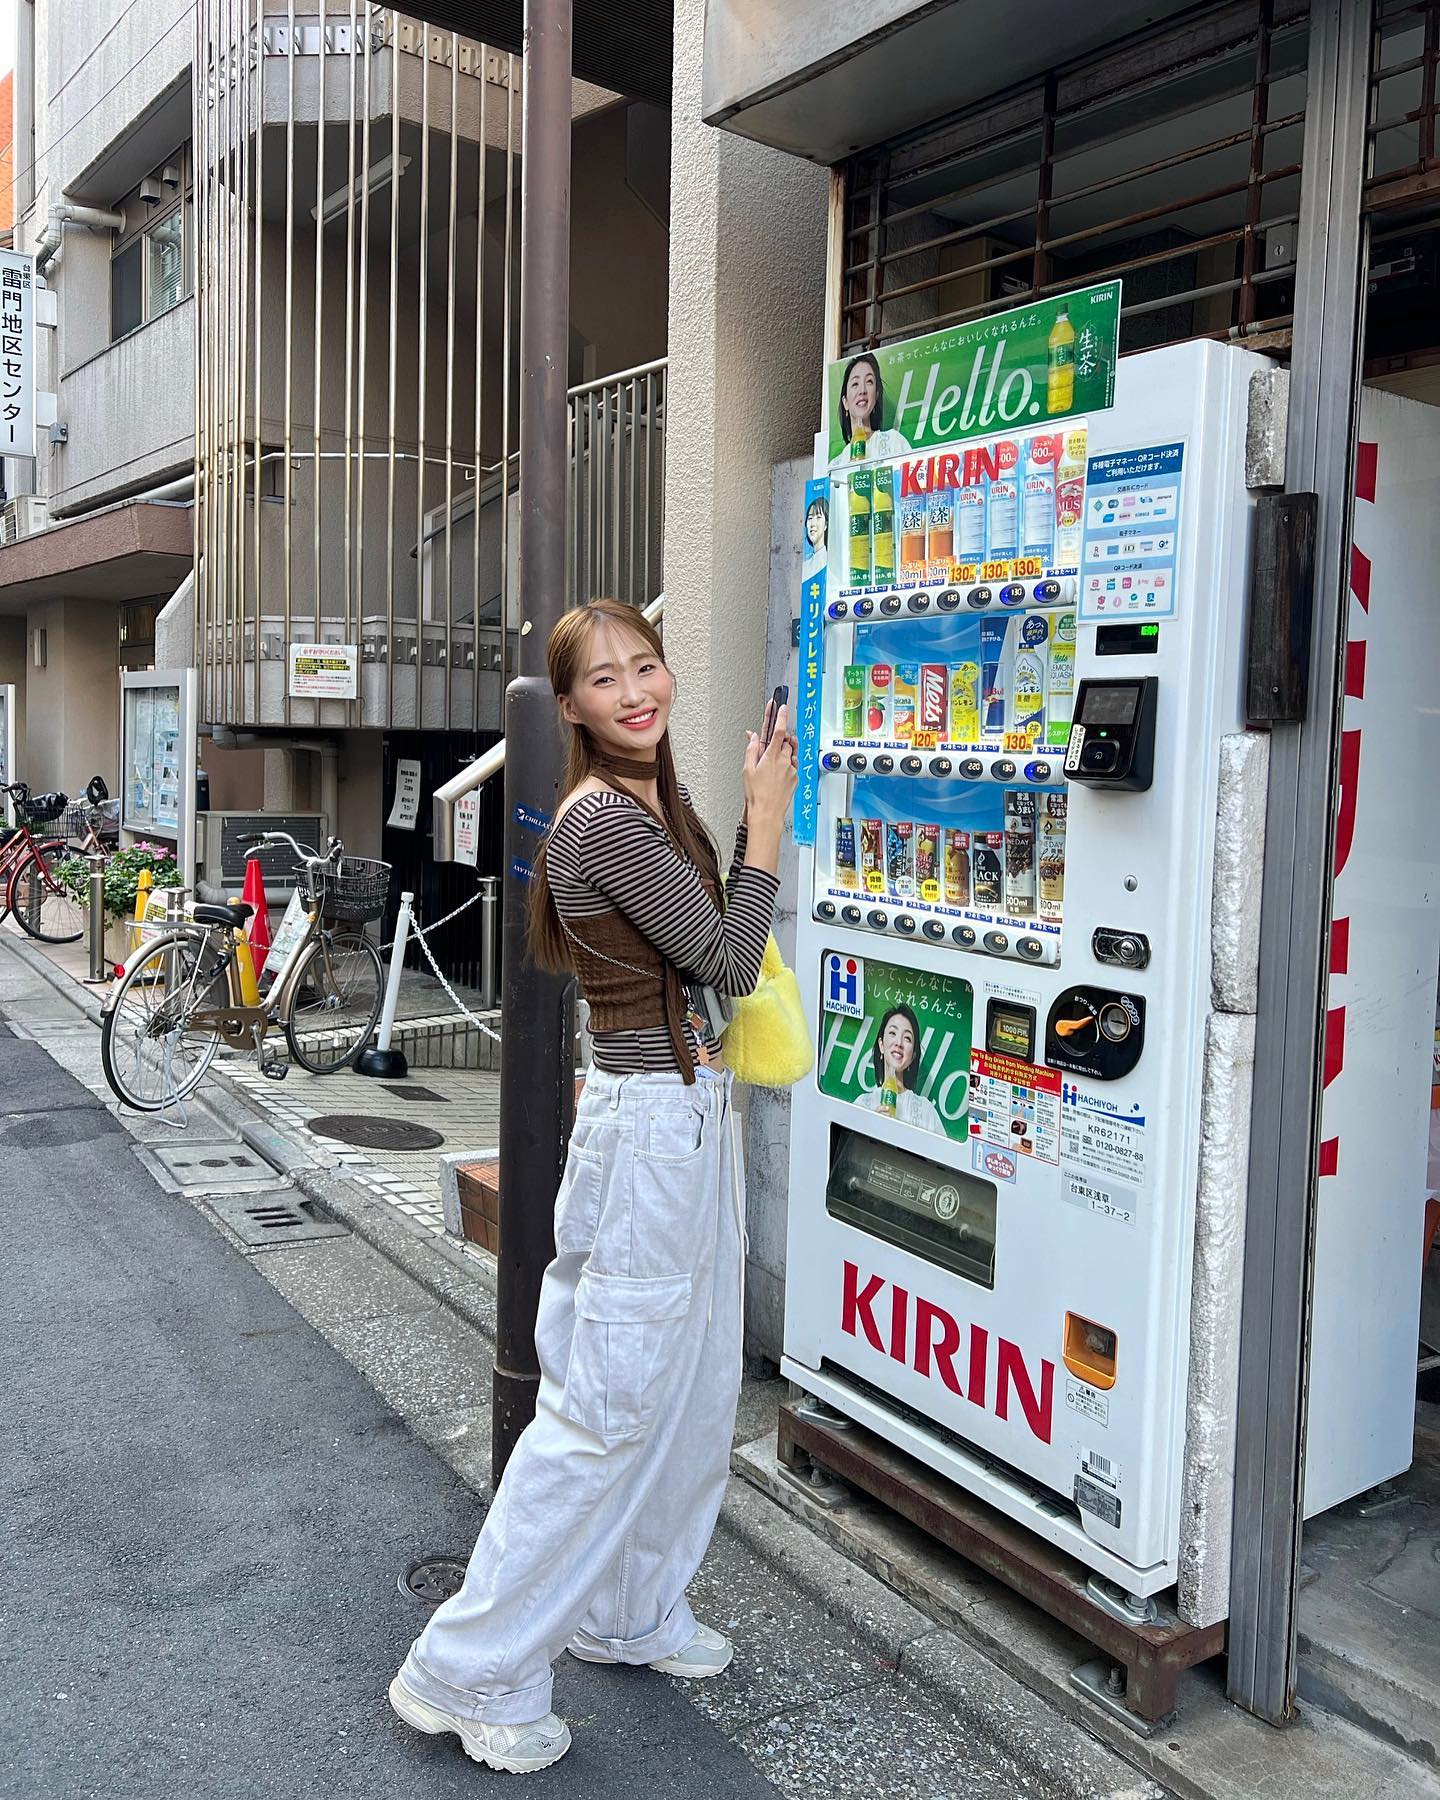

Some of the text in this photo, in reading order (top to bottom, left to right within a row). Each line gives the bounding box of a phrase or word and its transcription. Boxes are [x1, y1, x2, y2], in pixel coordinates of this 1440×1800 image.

[23, 264, 31, 289] 台東区
[1090, 292, 1113, 305] KIRIN
[2, 267, 23, 443] 雷門地区センター
[888, 315, 1042, 365] お茶って、こんなにおいしくなれるんだ。
[1079, 329, 1097, 377] 生茶
[893, 339, 1040, 441] Hello.
[900, 446, 1000, 498] KIRIN
[802, 582, 820, 830] キリンレモンが冷えてるぞ。
[926, 668, 944, 723] Mets
[825, 1000, 862, 1016] HACHIYOH
[1077, 1093, 1118, 1113] HACHIYOH
[1087, 1123, 1131, 1145] KR62171
[1070, 1183, 1110, 1203] 台東区浅草
[841, 1259, 1056, 1446] KIRIN
